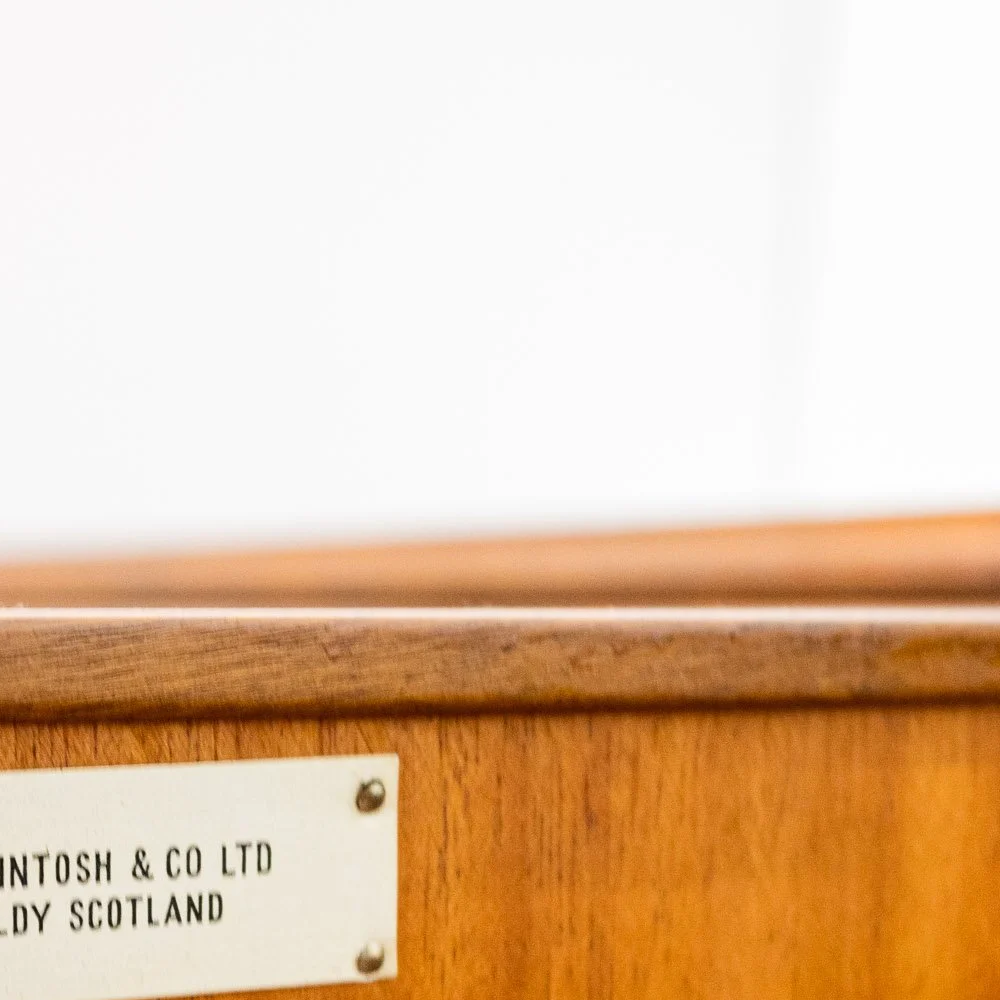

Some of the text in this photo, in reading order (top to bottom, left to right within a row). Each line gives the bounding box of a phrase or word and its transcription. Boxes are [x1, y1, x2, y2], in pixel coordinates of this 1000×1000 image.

[131, 848, 151, 880] &
[166, 845, 203, 878] CO
[221, 842, 274, 875] LTD
[69, 891, 224, 930] SCOTLAND
